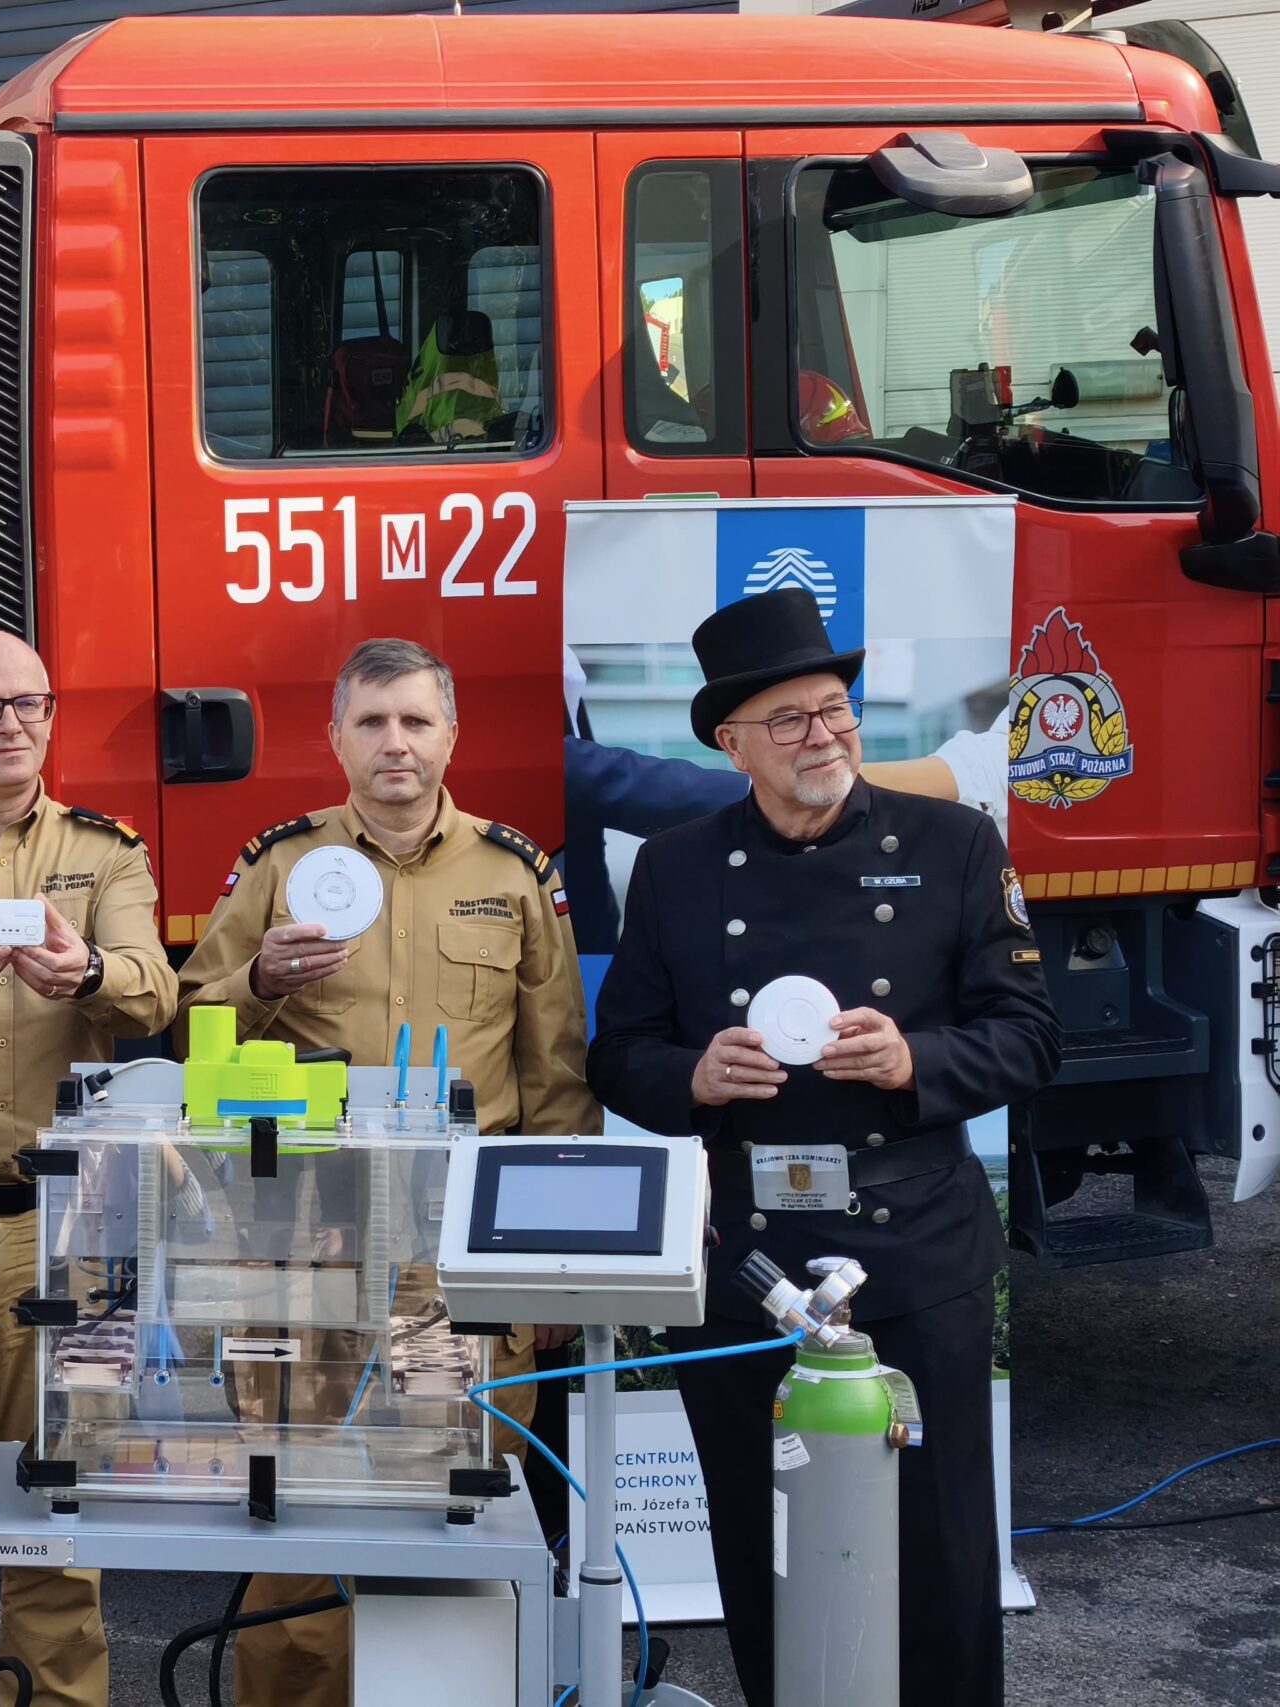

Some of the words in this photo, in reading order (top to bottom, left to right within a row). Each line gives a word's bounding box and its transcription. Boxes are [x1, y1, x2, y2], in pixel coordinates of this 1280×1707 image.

[224, 496, 357, 604] 551
[385, 518, 422, 576] M
[439, 491, 537, 597] 22
[1009, 759, 1046, 777] STWOWA
[1049, 752, 1075, 766] STRAŻ
[1081, 758, 1126, 773] POŻARNA
[455, 898, 508, 908] PAŃSTWOWA
[615, 1451, 694, 1466] CENTRUM
[615, 1474, 697, 1489] OCHRONY
[615, 1500, 637, 1512] im.
[642, 1497, 690, 1511] Józefa
[615, 1519, 711, 1535] PAŃSTWOW
